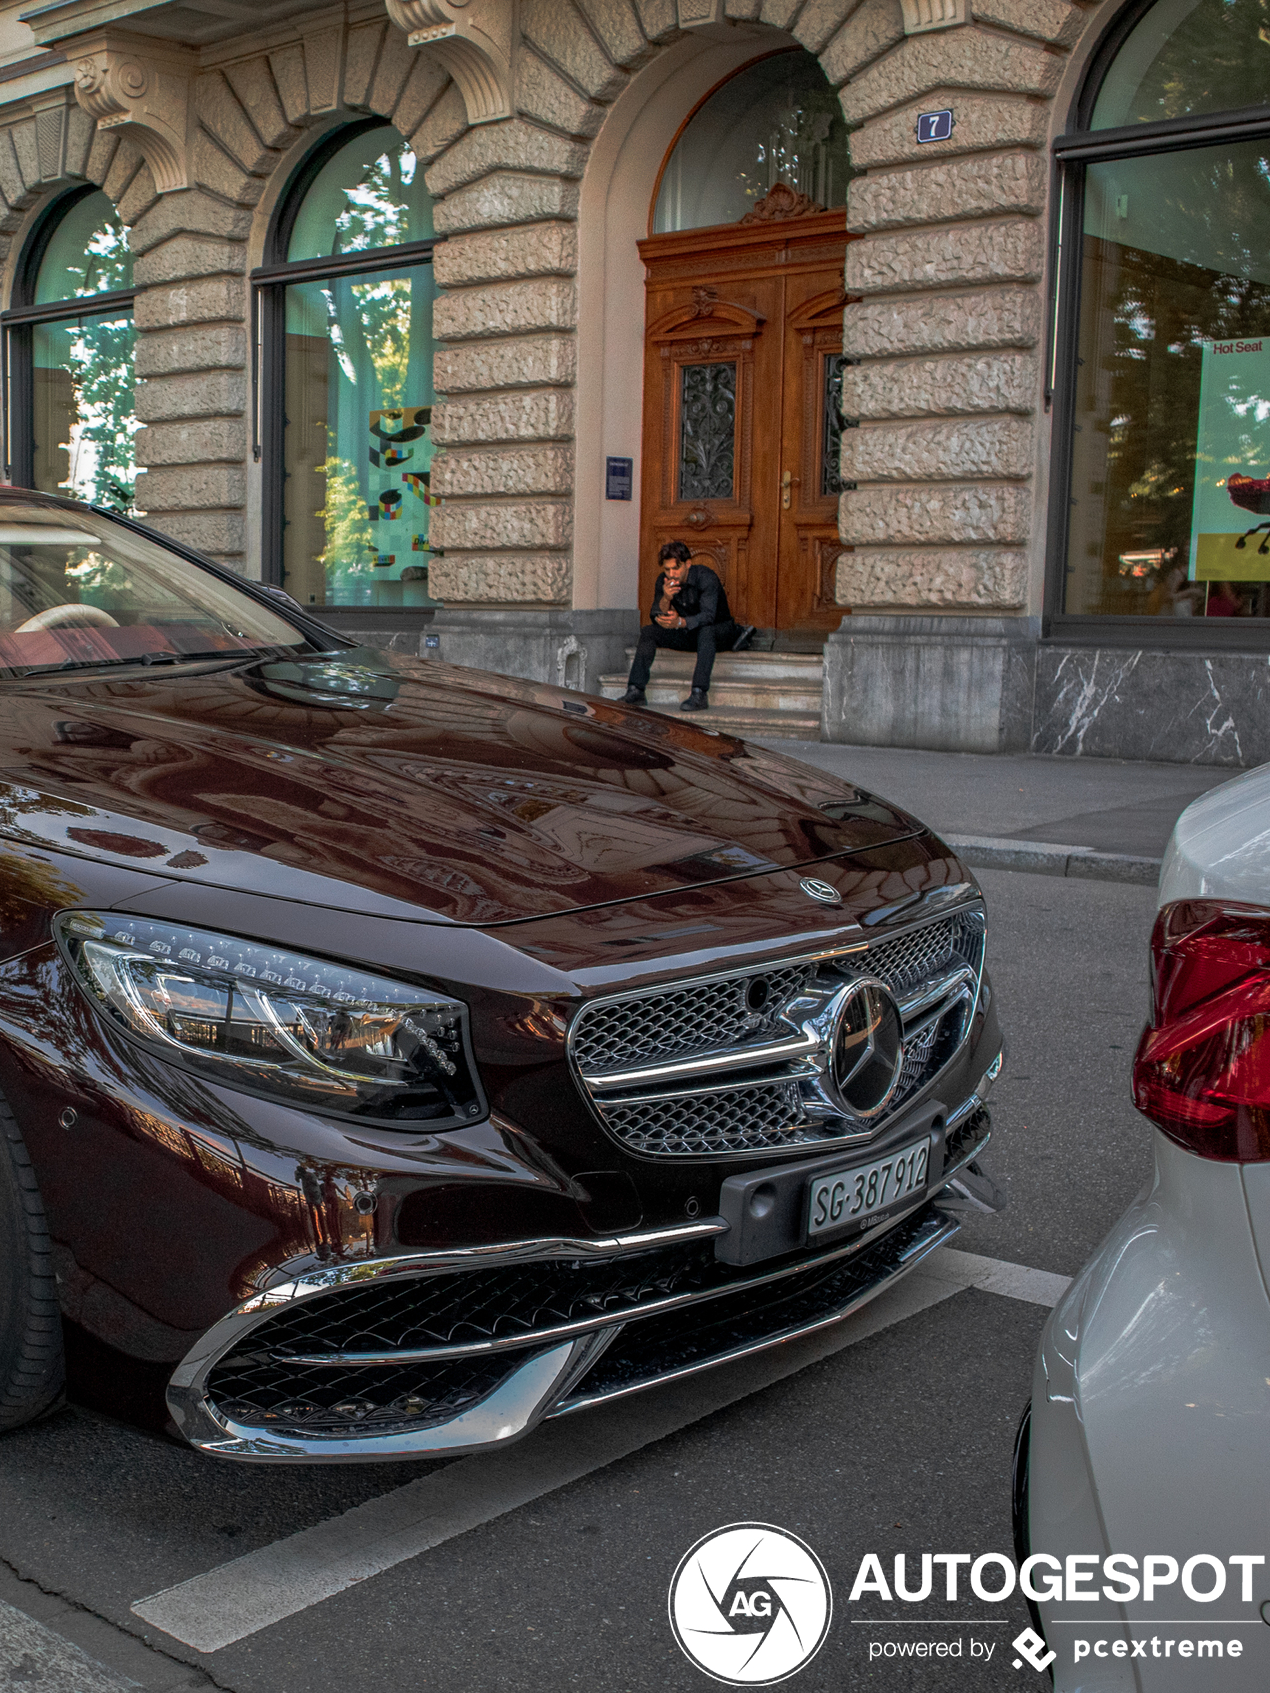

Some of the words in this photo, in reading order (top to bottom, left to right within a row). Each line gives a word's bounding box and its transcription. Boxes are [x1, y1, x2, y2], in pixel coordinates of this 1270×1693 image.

[929, 115, 940, 137] 7
[1213, 342, 1234, 355] Hot
[1235, 340, 1263, 353] Seat
